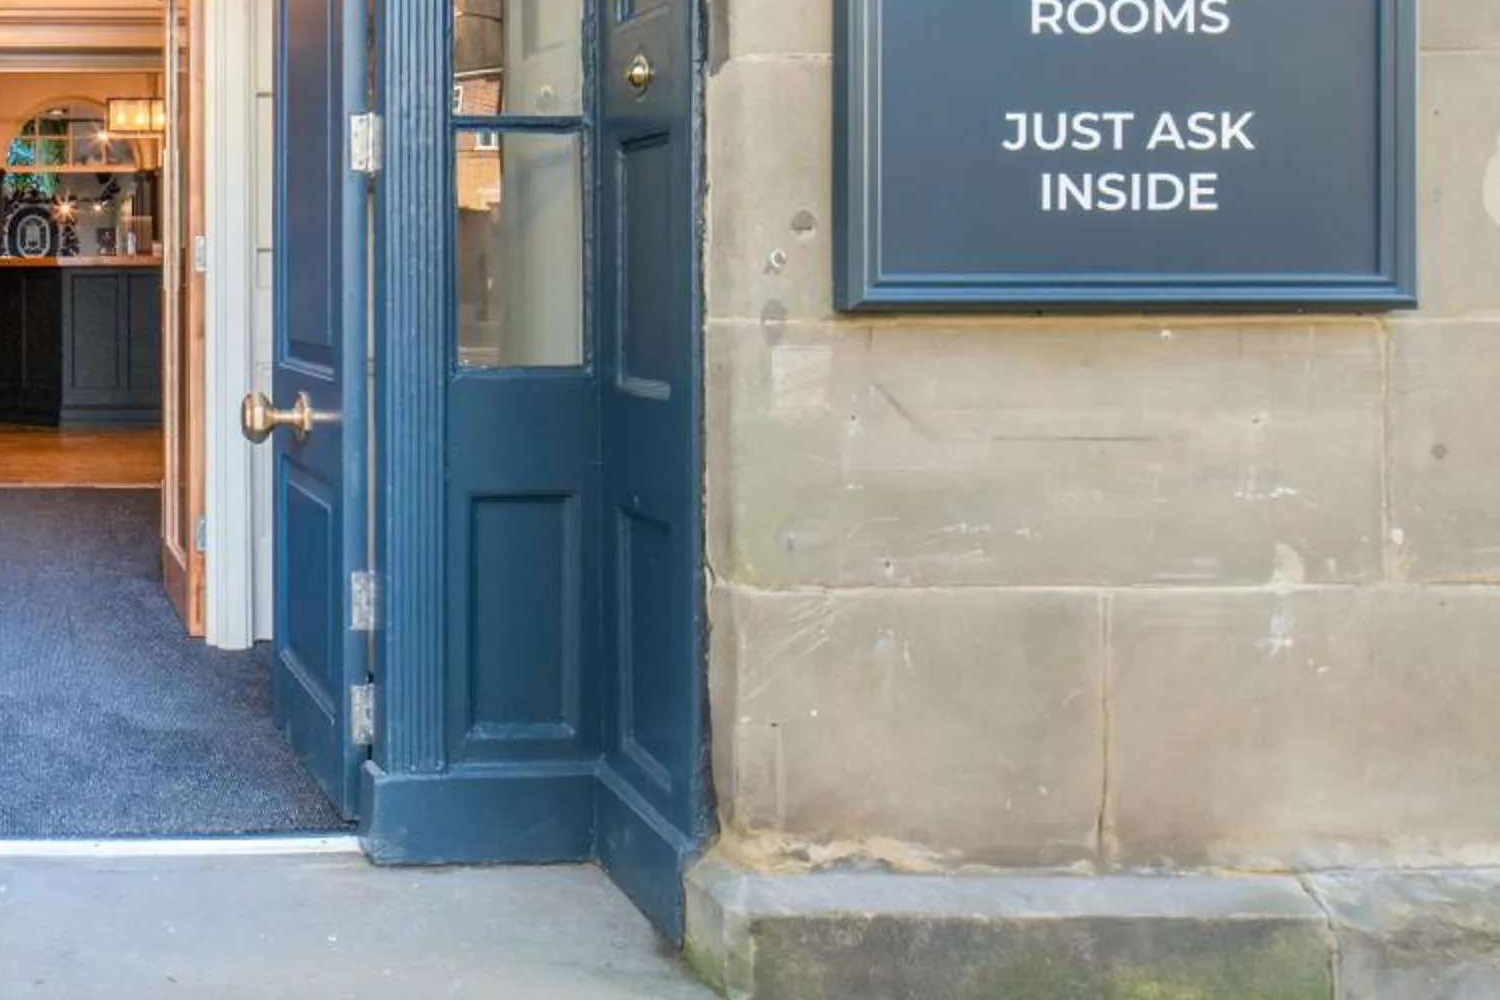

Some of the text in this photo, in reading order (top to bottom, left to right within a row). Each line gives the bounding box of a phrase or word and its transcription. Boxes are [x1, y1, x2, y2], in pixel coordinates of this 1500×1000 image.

[1002, 111, 1255, 151] JUST ASK
[1041, 172, 1219, 211] INSIDE
